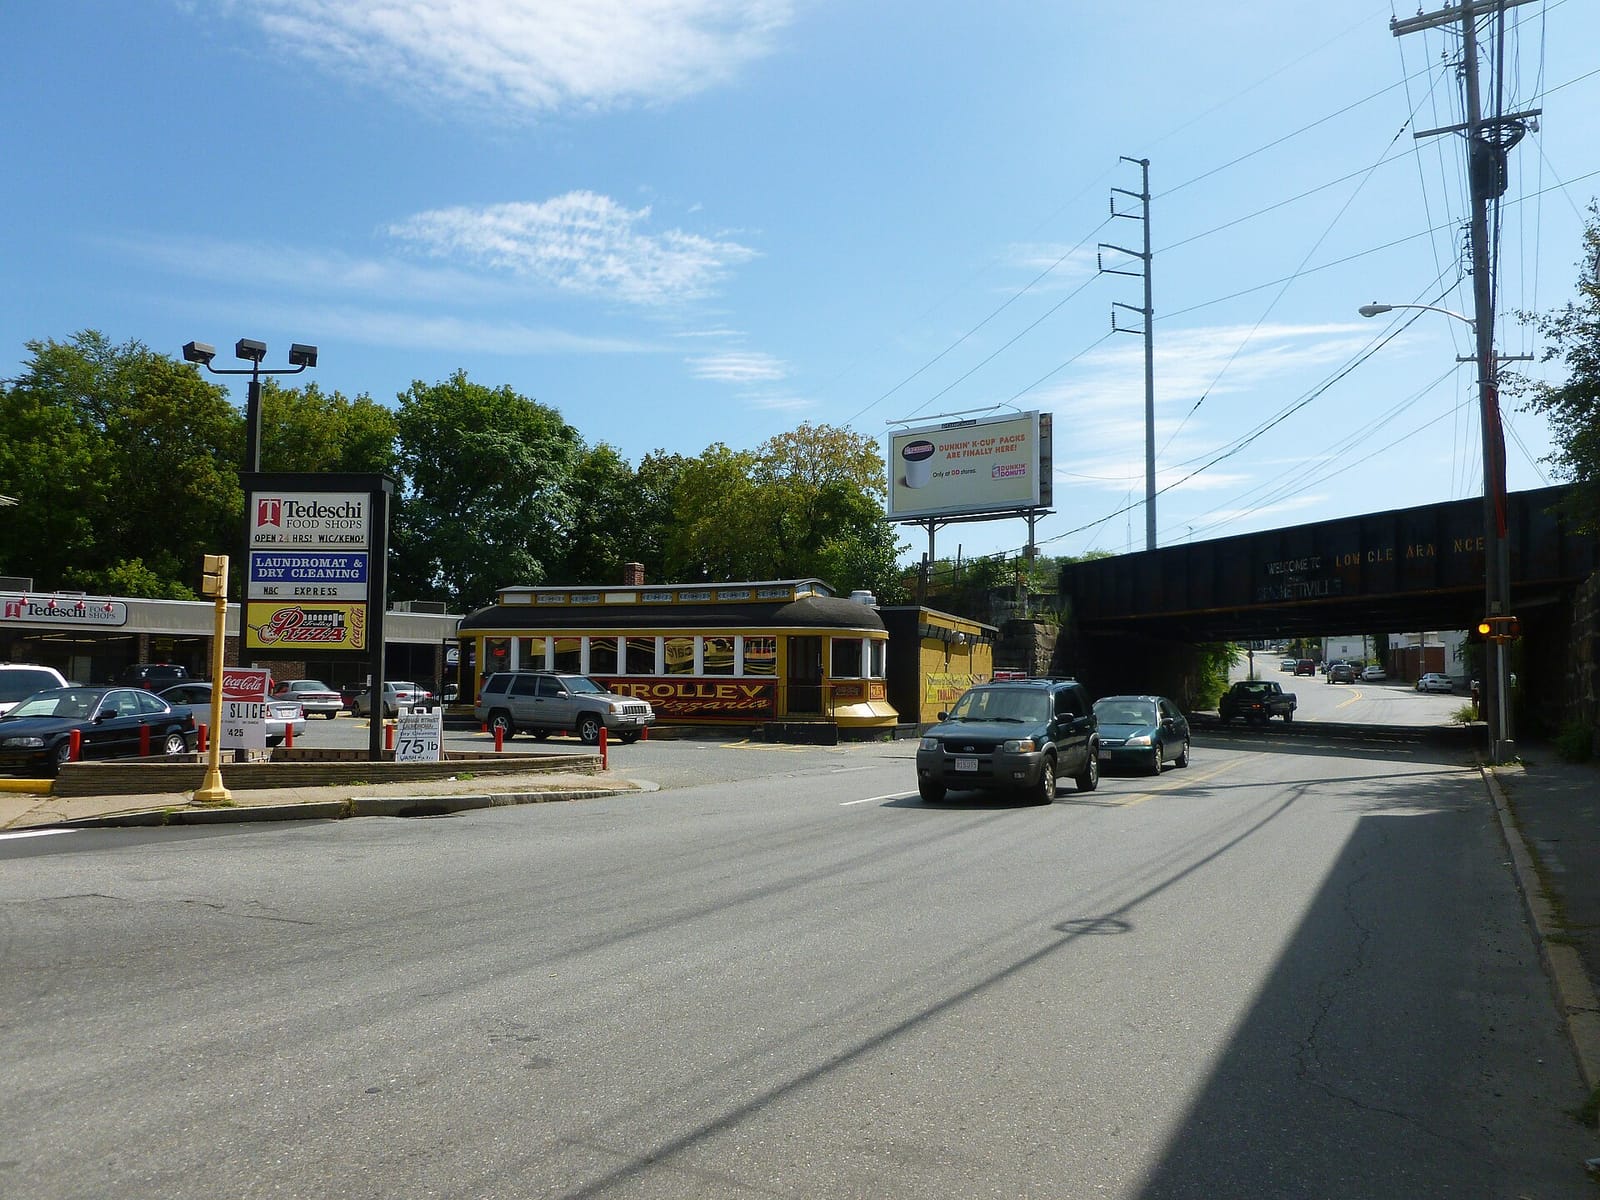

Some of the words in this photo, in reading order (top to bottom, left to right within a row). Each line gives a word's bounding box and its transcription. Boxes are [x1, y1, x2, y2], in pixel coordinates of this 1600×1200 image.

[1000, 434, 1025, 444] PACKS
[946, 451, 960, 459] ARE
[963, 447, 993, 457] FINALLY
[995, 444, 1017, 453] HERE!
[932, 470, 944, 478] Only
[1001, 469, 1026, 477] DONUTS
[283, 500, 362, 518] Tedeschi
[287, 520, 319, 528] FOOD
[325, 520, 362, 529] SHOPS
[255, 534, 276, 543] OPEN
[293, 535, 312, 543] HRS!
[256, 558, 347, 568] LAUNDROMAT
[353, 559, 363, 568] &
[1336, 553, 1360, 567] LOW
[258, 569, 285, 578] DRY
[291, 569, 359, 578] CLEANING
[294, 587, 338, 596] EXPRESS
[27, 603, 86, 618] Tedeschi
[610, 684, 764, 699] TROLLEY
[230, 703, 265, 718] SLICE
[400, 739, 424, 755] 75
[427, 741, 439, 751] lb
